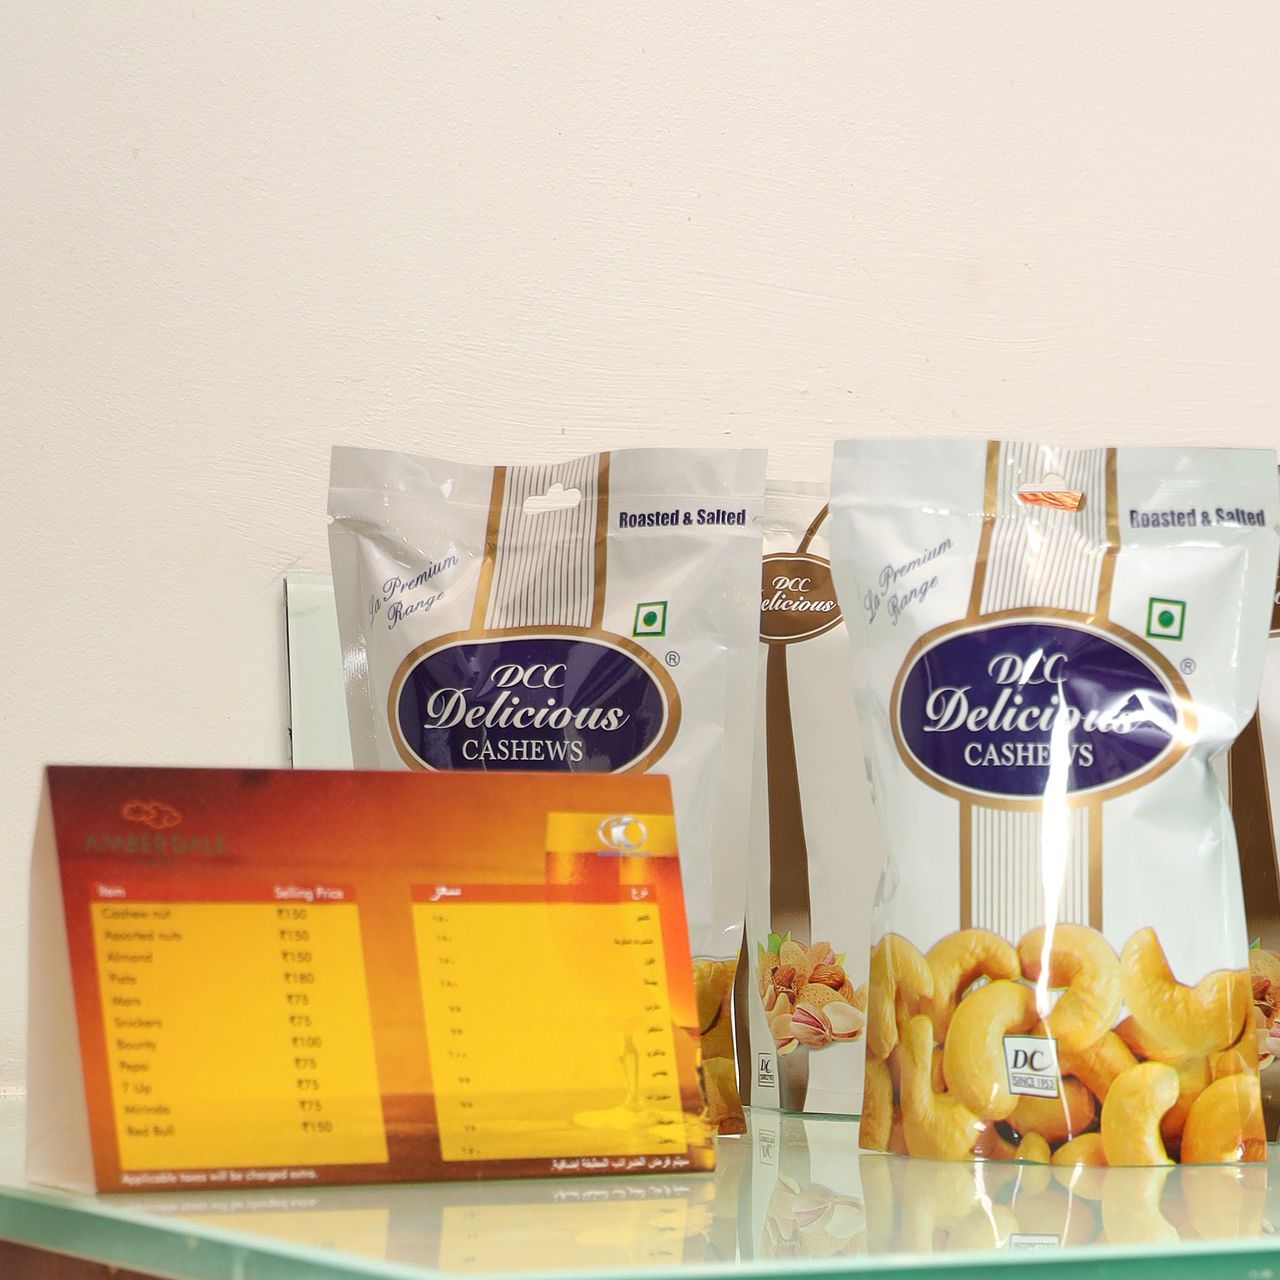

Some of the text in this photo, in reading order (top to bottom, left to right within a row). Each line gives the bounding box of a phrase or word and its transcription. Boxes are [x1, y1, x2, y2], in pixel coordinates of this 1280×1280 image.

[619, 509, 746, 528] Roasted & Salted
[1129, 507, 1266, 528] Roasted & Salted
[383, 553, 459, 601] Premium
[879, 538, 954, 597] Premium
[772, 576, 812, 592] DCC
[387, 589, 445, 630] Range
[761, 591, 836, 613] elicious
[886, 575, 940, 627] Range
[490, 663, 567, 689] DCC
[424, 687, 631, 731] Delicious
[462, 739, 583, 762] CASHEWS
[97, 885, 127, 898] Item
[274, 885, 344, 902] Selling Price
[122, 1173, 177, 1186] Applicable
[209, 1170, 228, 1182] will
[229, 1170, 244, 1182] be
[245, 1169, 288, 1182] charged
